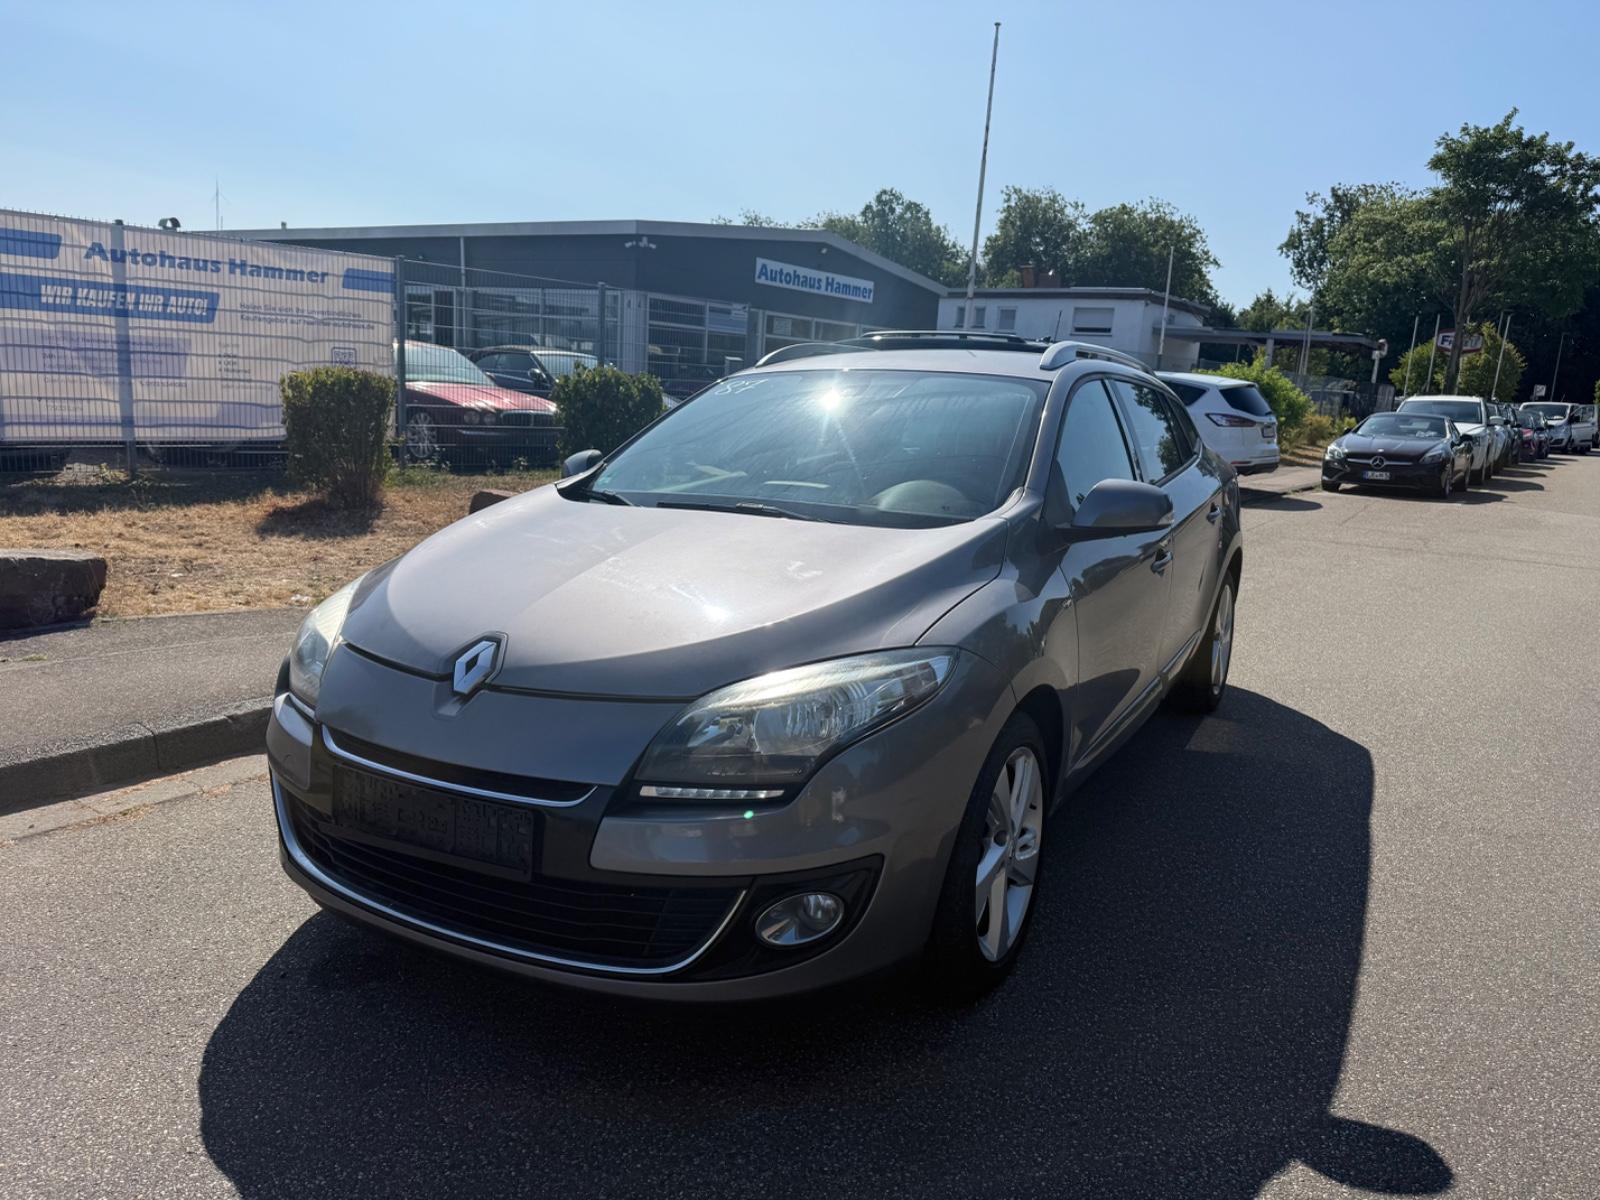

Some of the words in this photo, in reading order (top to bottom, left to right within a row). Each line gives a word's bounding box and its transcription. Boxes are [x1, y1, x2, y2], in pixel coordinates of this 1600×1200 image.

[83, 241, 222, 273] Autohaus
[228, 258, 329, 283] Hammer
[41, 284, 73, 305] WIR
[76, 287, 136, 311] KAUFEN
[139, 293, 164, 313] IHR
[167, 295, 208, 316] AUTO!
[757, 263, 822, 290] Autohaus
[824, 276, 873, 300] Hammer
